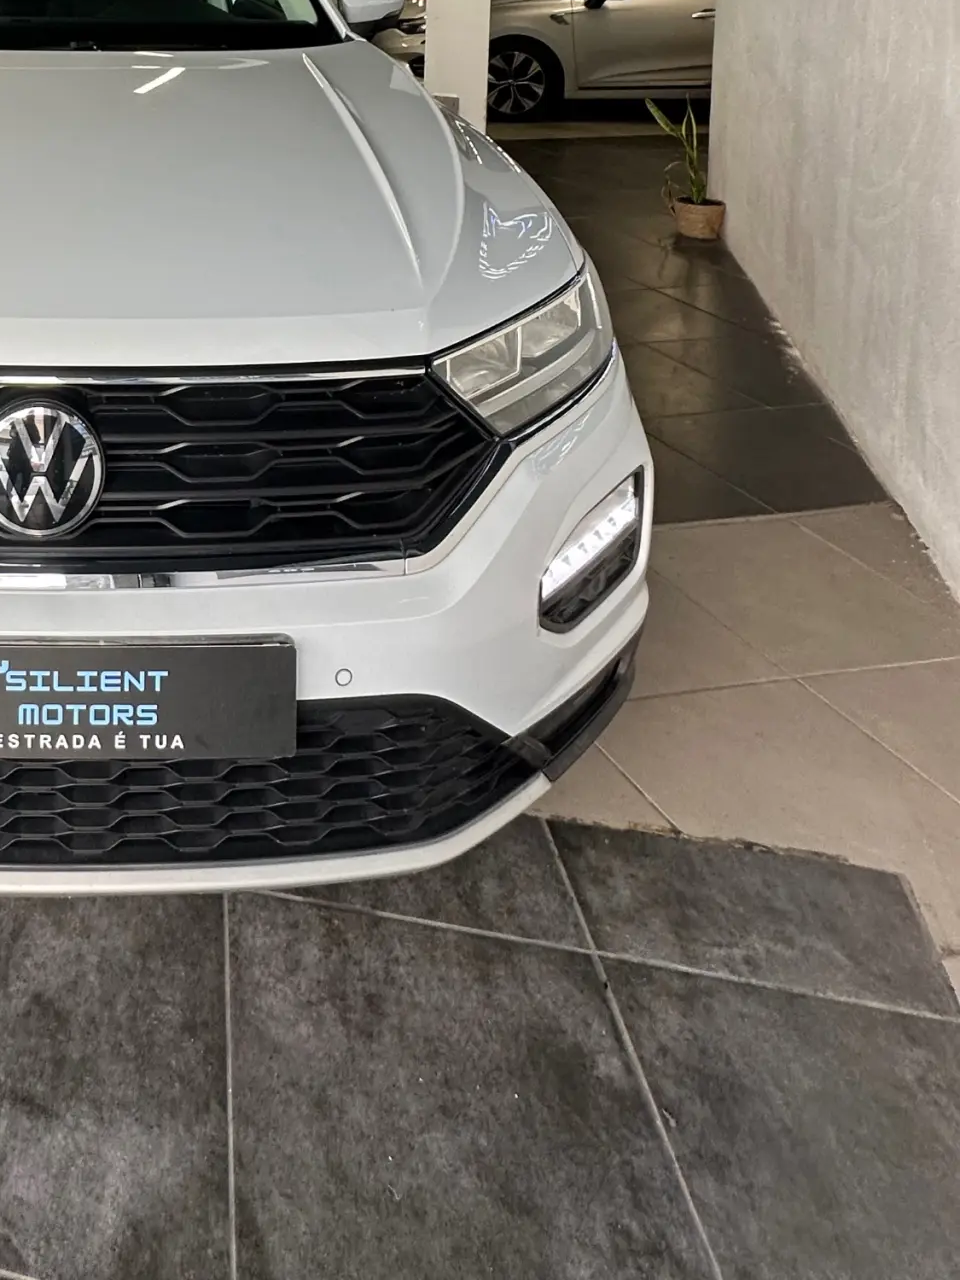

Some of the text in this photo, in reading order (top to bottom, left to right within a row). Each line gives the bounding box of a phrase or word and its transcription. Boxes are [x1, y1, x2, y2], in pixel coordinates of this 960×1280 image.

[18, 703, 158, 726] MOTORS
[114, 730, 127, 750] É
[139, 734, 185, 750] TUA
